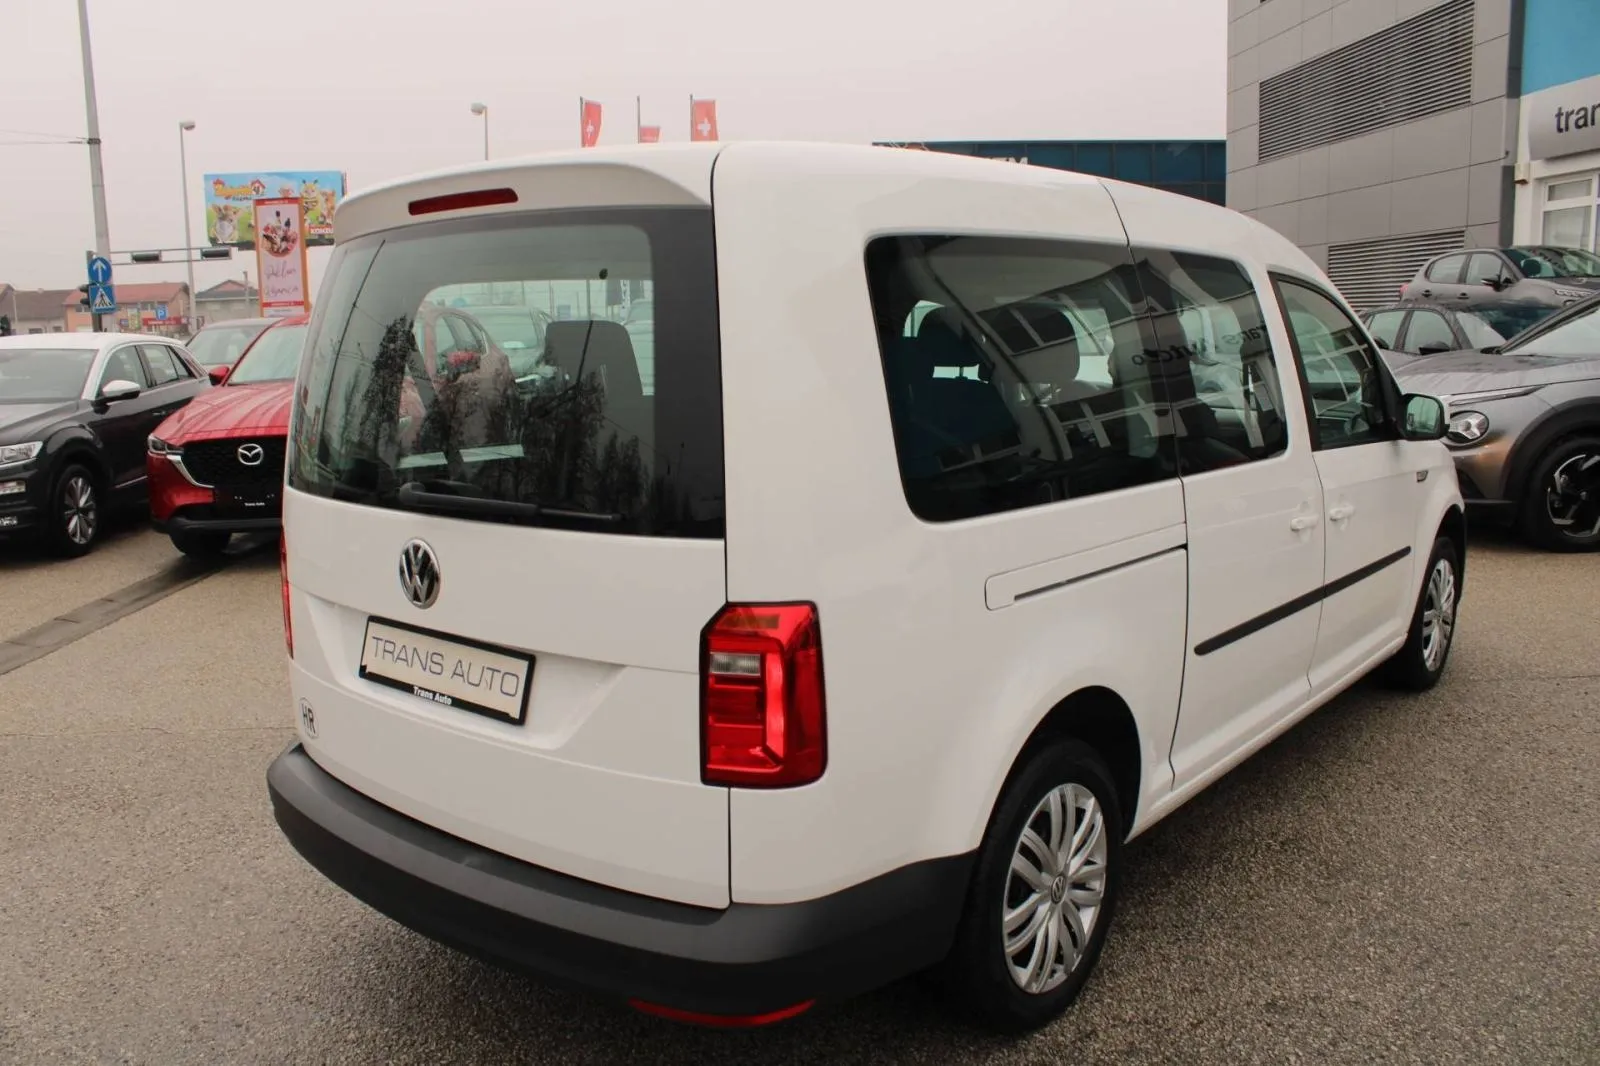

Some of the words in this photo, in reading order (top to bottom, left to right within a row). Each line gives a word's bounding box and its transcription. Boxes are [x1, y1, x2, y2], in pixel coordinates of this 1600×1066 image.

[372, 636, 445, 676] TRANS
[450, 658, 520, 698] AUTO
[413, 685, 434, 701] Trans
[434, 692, 452, 706] Auto
[301, 703, 316, 735] HR
